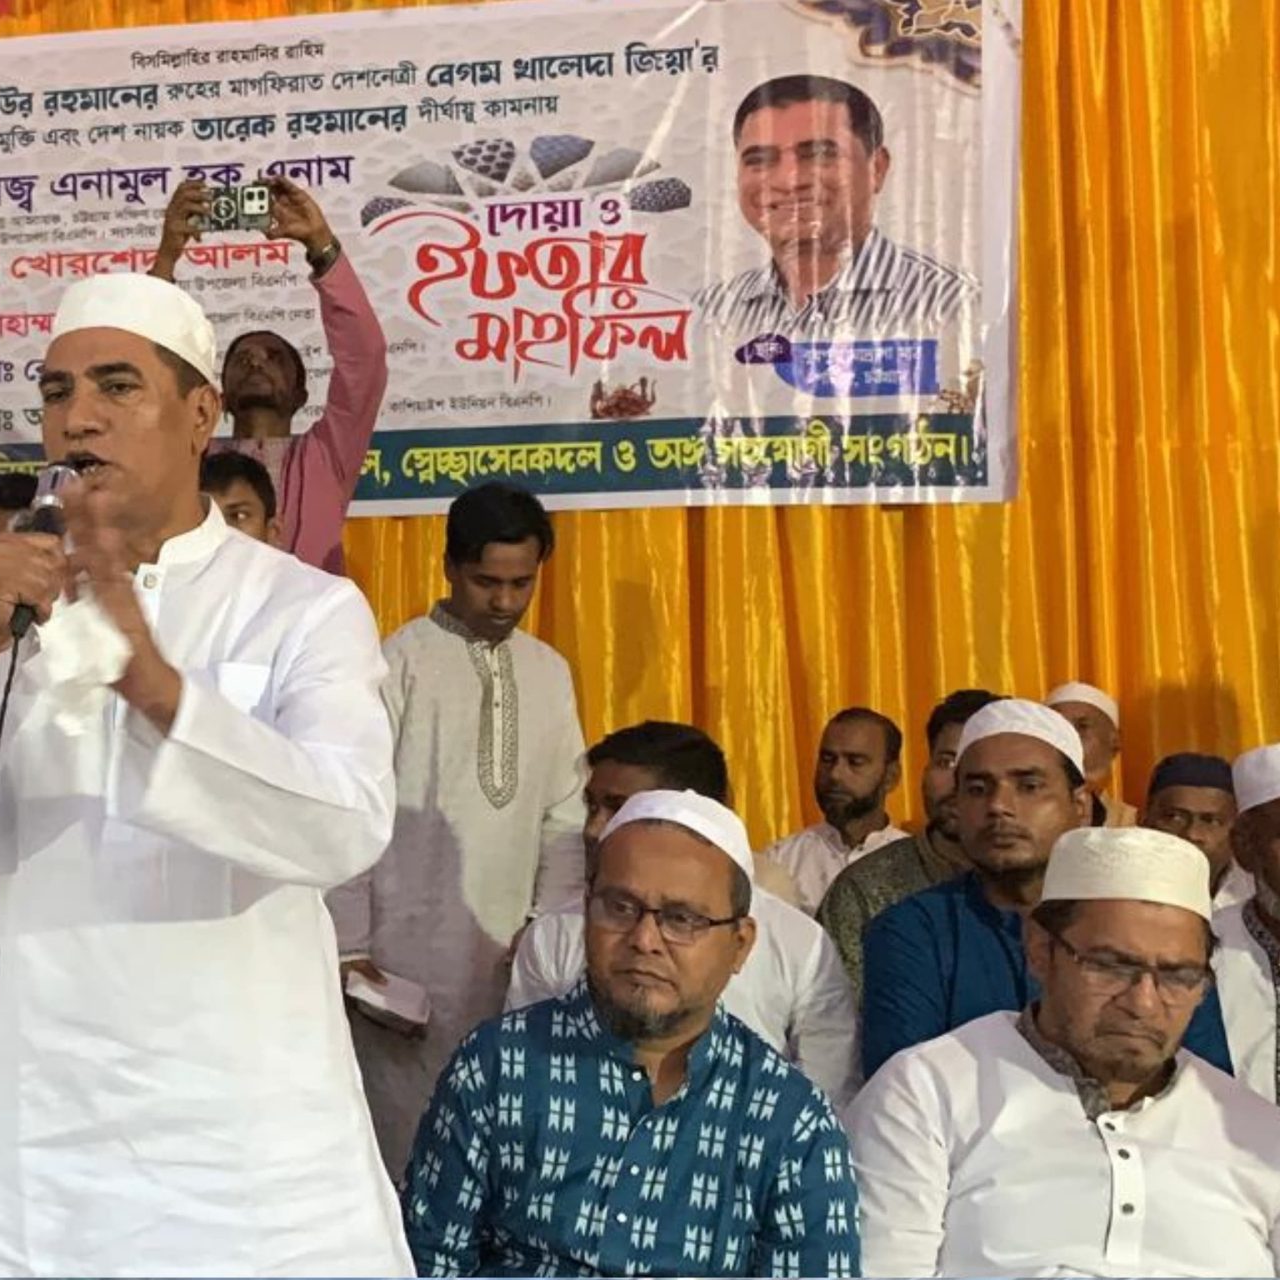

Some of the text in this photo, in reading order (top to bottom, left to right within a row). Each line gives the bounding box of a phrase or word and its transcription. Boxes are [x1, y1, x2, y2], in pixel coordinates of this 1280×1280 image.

[43, 83, 158, 117] রহমানের
[166, 80, 221, 100] রুহের
[228, 71, 325, 98] মাগফিরাত
[332, 60, 418, 91] দেশনেত্রী
[427, 60, 501, 87] বেগম
[514, 51, 613, 80] খালেদা
[625, 39, 719, 76] জিয়া'র
[131, 39, 325, 69] বিসমিল্লাহির রাহমানির রাহিম
[43, 127, 81, 147] এবং
[88, 123, 126, 144] দেশ
[134, 120, 185, 141] নায়ক
[191, 114, 276, 141] তারেক
[286, 105, 407, 139] রহমানের
[418, 95, 476, 124] দীর্ঘায়ু
[483, 95, 559, 118] কামনায়
[50, 166, 172, 204] এনামুল
[266, 155, 354, 187] এনাম
[485, 198, 622, 237] দোয়া ও
[185, 241, 293, 269] আলম
[368, 210, 650, 328] ইফতার
[455, 281, 693, 385] মাহফিল
[401, 441, 603, 487] স্বেচ্ছাসেবকদল
[613, 440, 637, 473] ও
